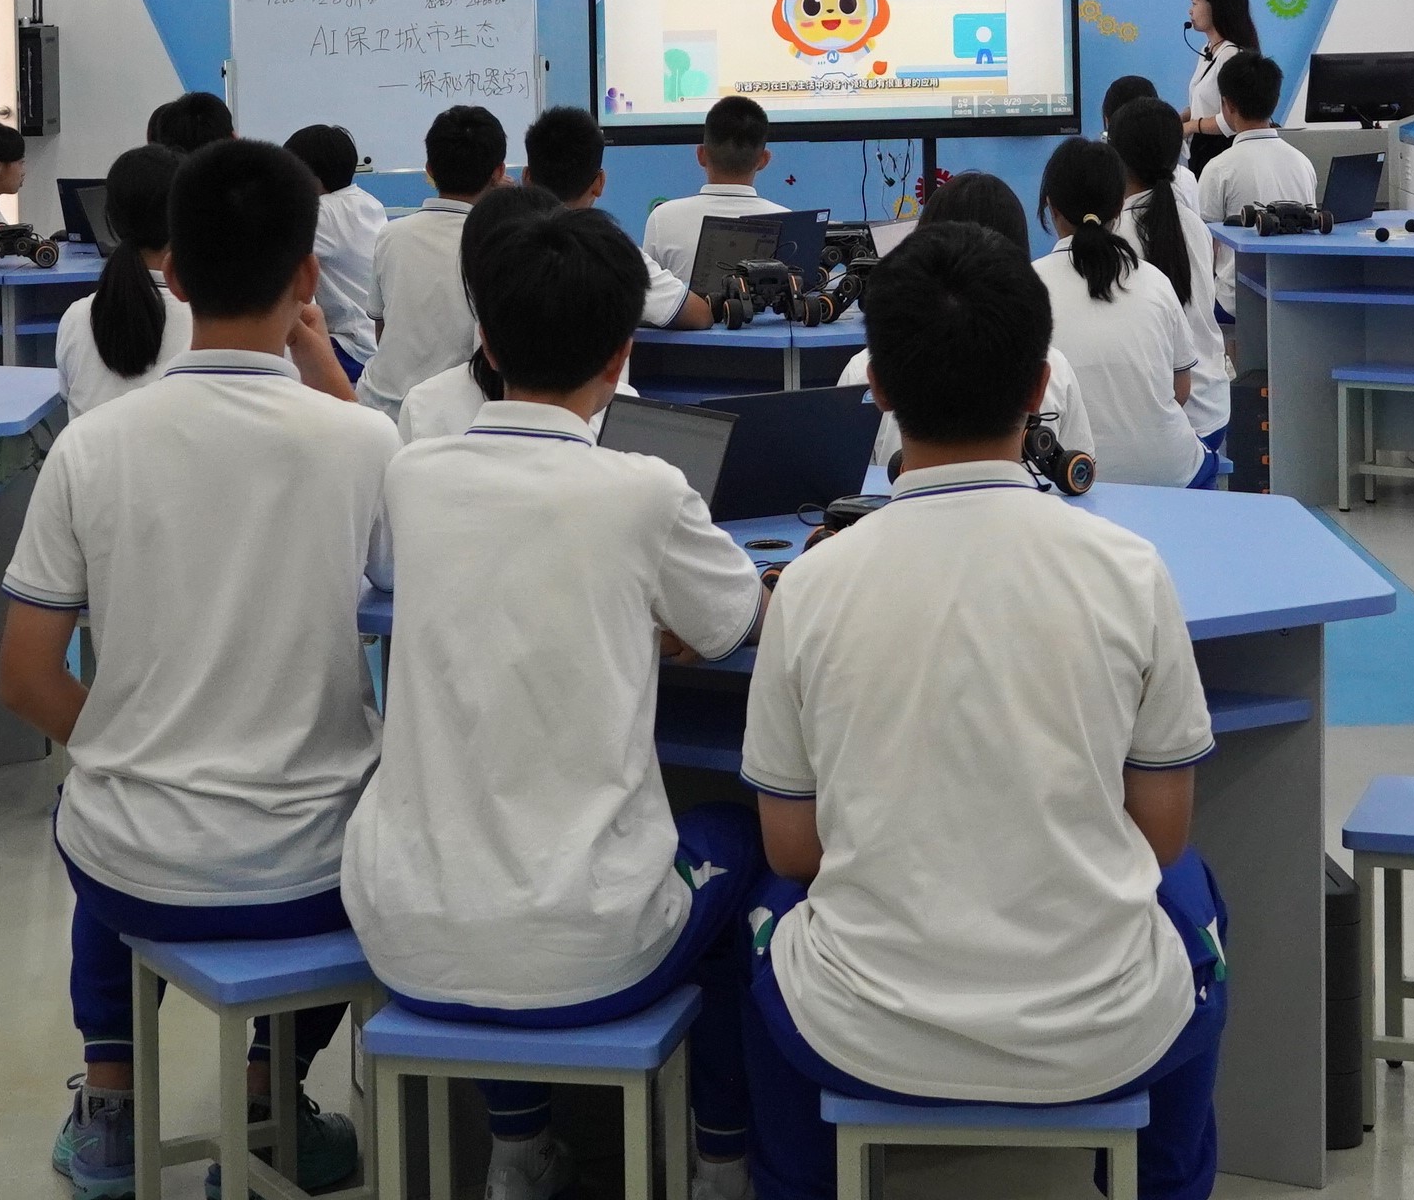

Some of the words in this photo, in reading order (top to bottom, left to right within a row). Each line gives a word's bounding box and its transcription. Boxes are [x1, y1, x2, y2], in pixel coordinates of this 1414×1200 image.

[309, 19, 500, 57] AI保卫城市生态
[828, 52, 838, 61] AI
[1003, 97, 1022, 106] 8/29
